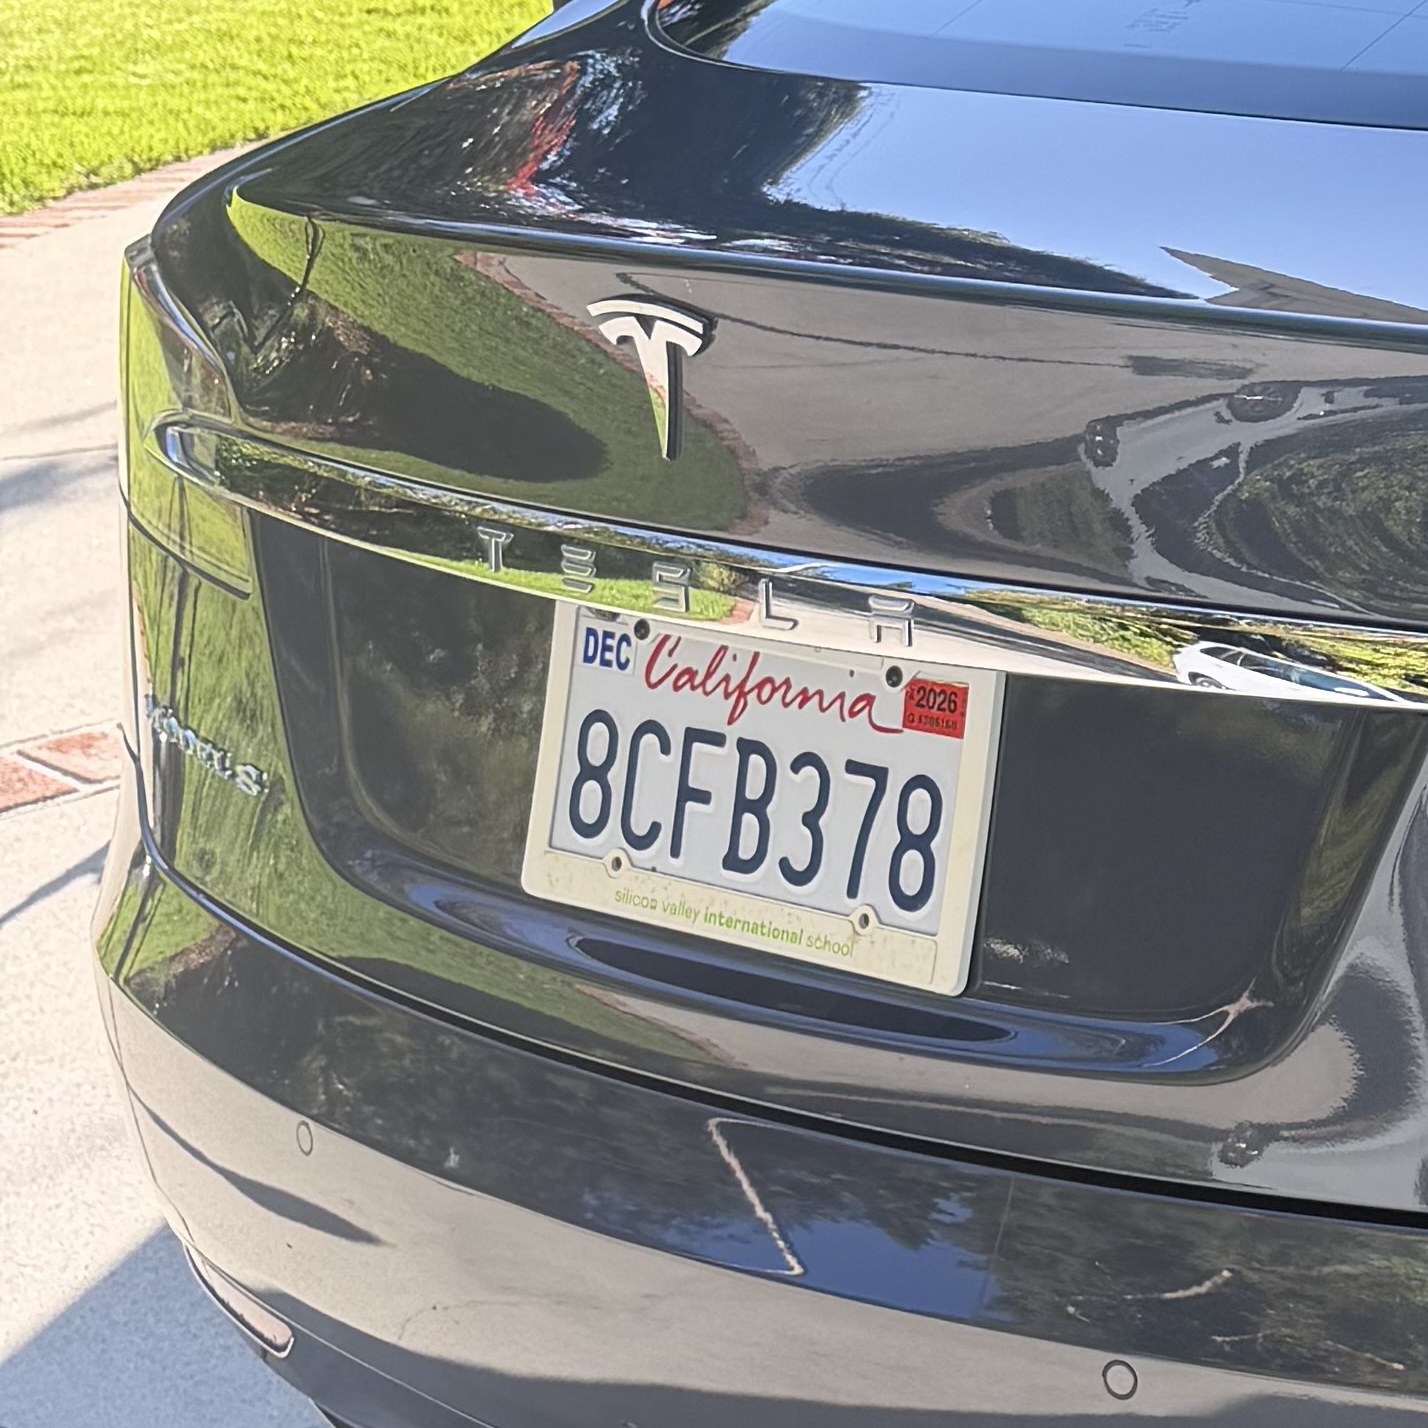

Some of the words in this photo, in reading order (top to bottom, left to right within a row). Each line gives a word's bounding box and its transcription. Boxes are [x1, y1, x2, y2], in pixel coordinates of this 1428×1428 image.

[476, 525, 916, 648] TESLA
[582, 626, 632, 671] DEC
[644, 633, 904, 734] California
[915, 685, 958, 714] 2026
[568, 709, 943, 912] 8CFB378
[614, 888, 657, 911] silicon
[662, 901, 700, 923] valley
[703, 906, 804, 945] international
[806, 933, 855, 959] school
